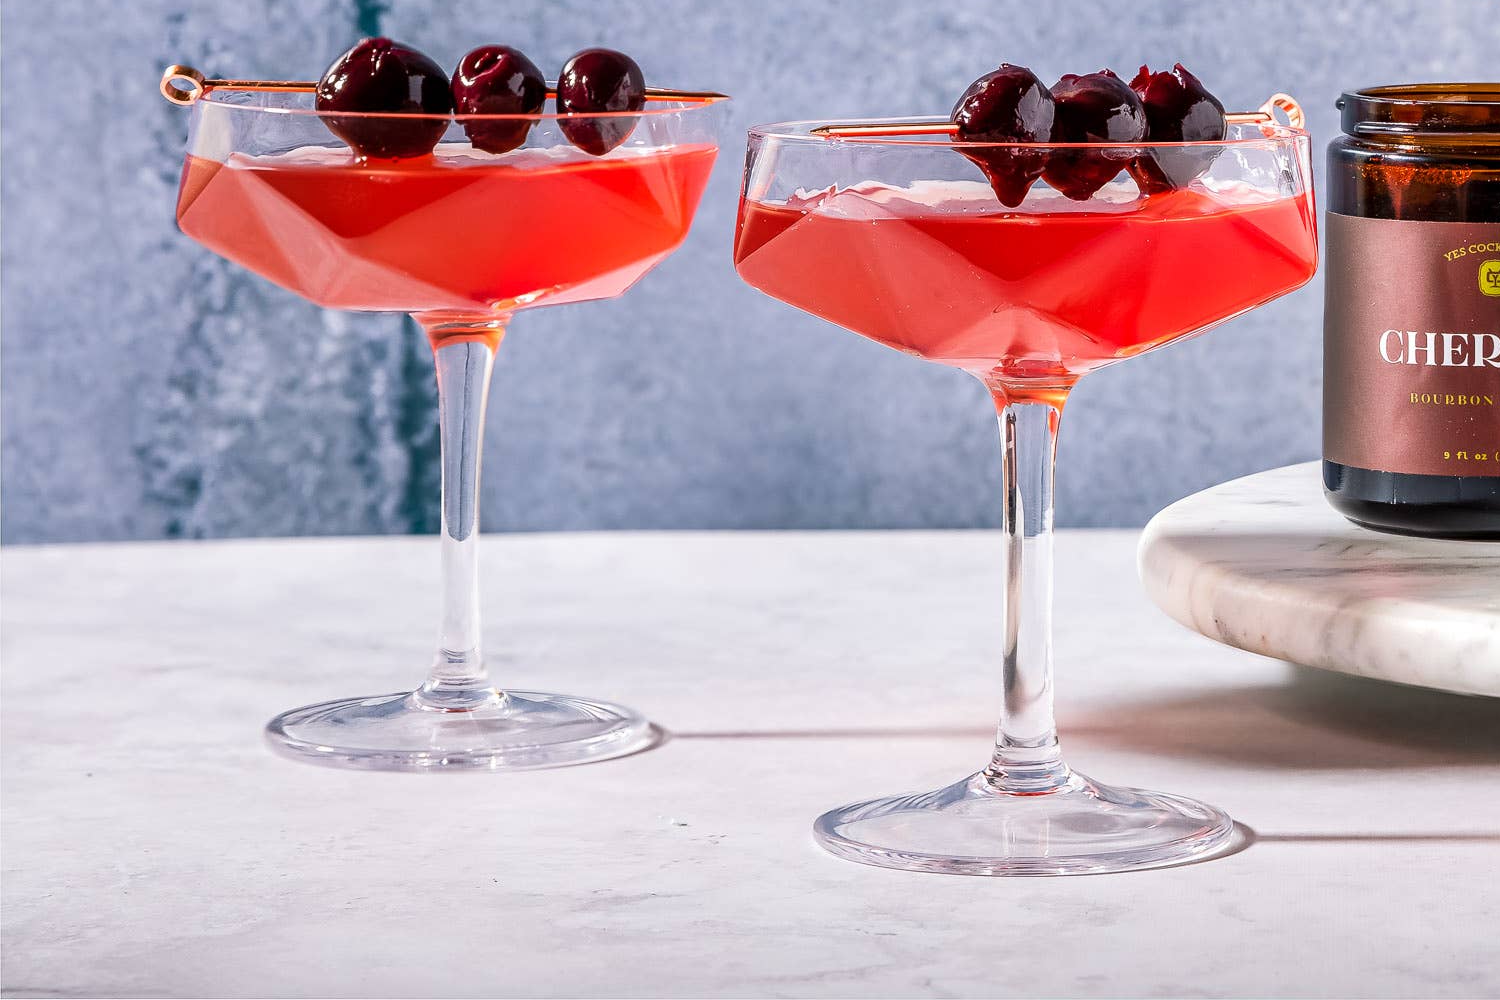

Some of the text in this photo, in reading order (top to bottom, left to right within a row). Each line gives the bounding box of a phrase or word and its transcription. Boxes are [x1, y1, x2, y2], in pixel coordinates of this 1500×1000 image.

[1443, 247, 1467, 262] YES
[1410, 392, 1493, 406] BOURBON
[1443, 452, 1450, 460] 9
[1456, 452, 1468, 461] fl
[1474, 453, 1487, 461] oz
